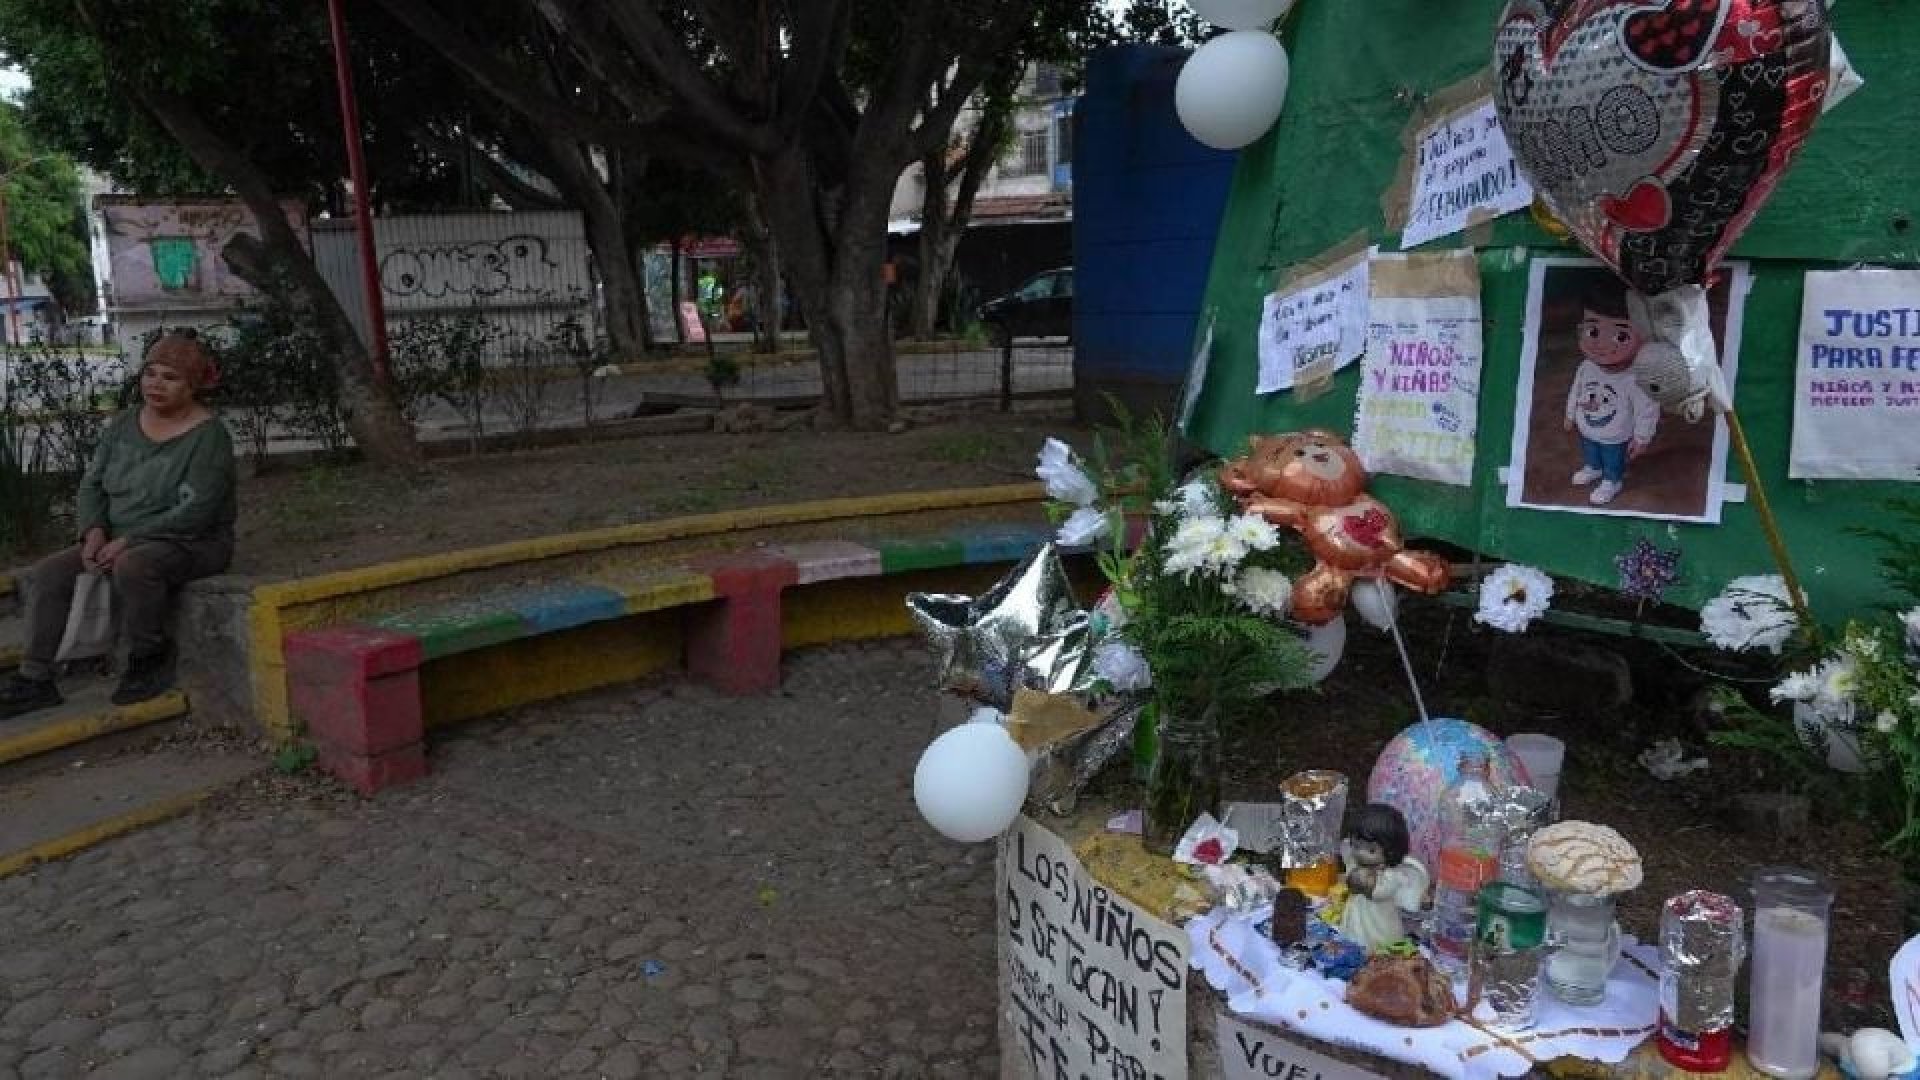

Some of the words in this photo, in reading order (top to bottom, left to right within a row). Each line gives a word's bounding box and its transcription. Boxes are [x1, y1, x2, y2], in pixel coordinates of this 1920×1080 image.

[1389, 339, 1454, 367] NIÑOS
[1811, 343, 1883, 369] PARA
[1373, 368, 1387, 391] Y
[1391, 369, 1451, 393] NIÑAS
[1810, 380, 1873, 393] NIÑOS
[1017, 831, 1069, 902] LOS
[1072, 880, 1181, 990] NIÑOS
[1029, 901, 1059, 968] SE
[1061, 925, 1138, 1035] TOCAN
[1235, 1031, 1322, 1080] VUE
